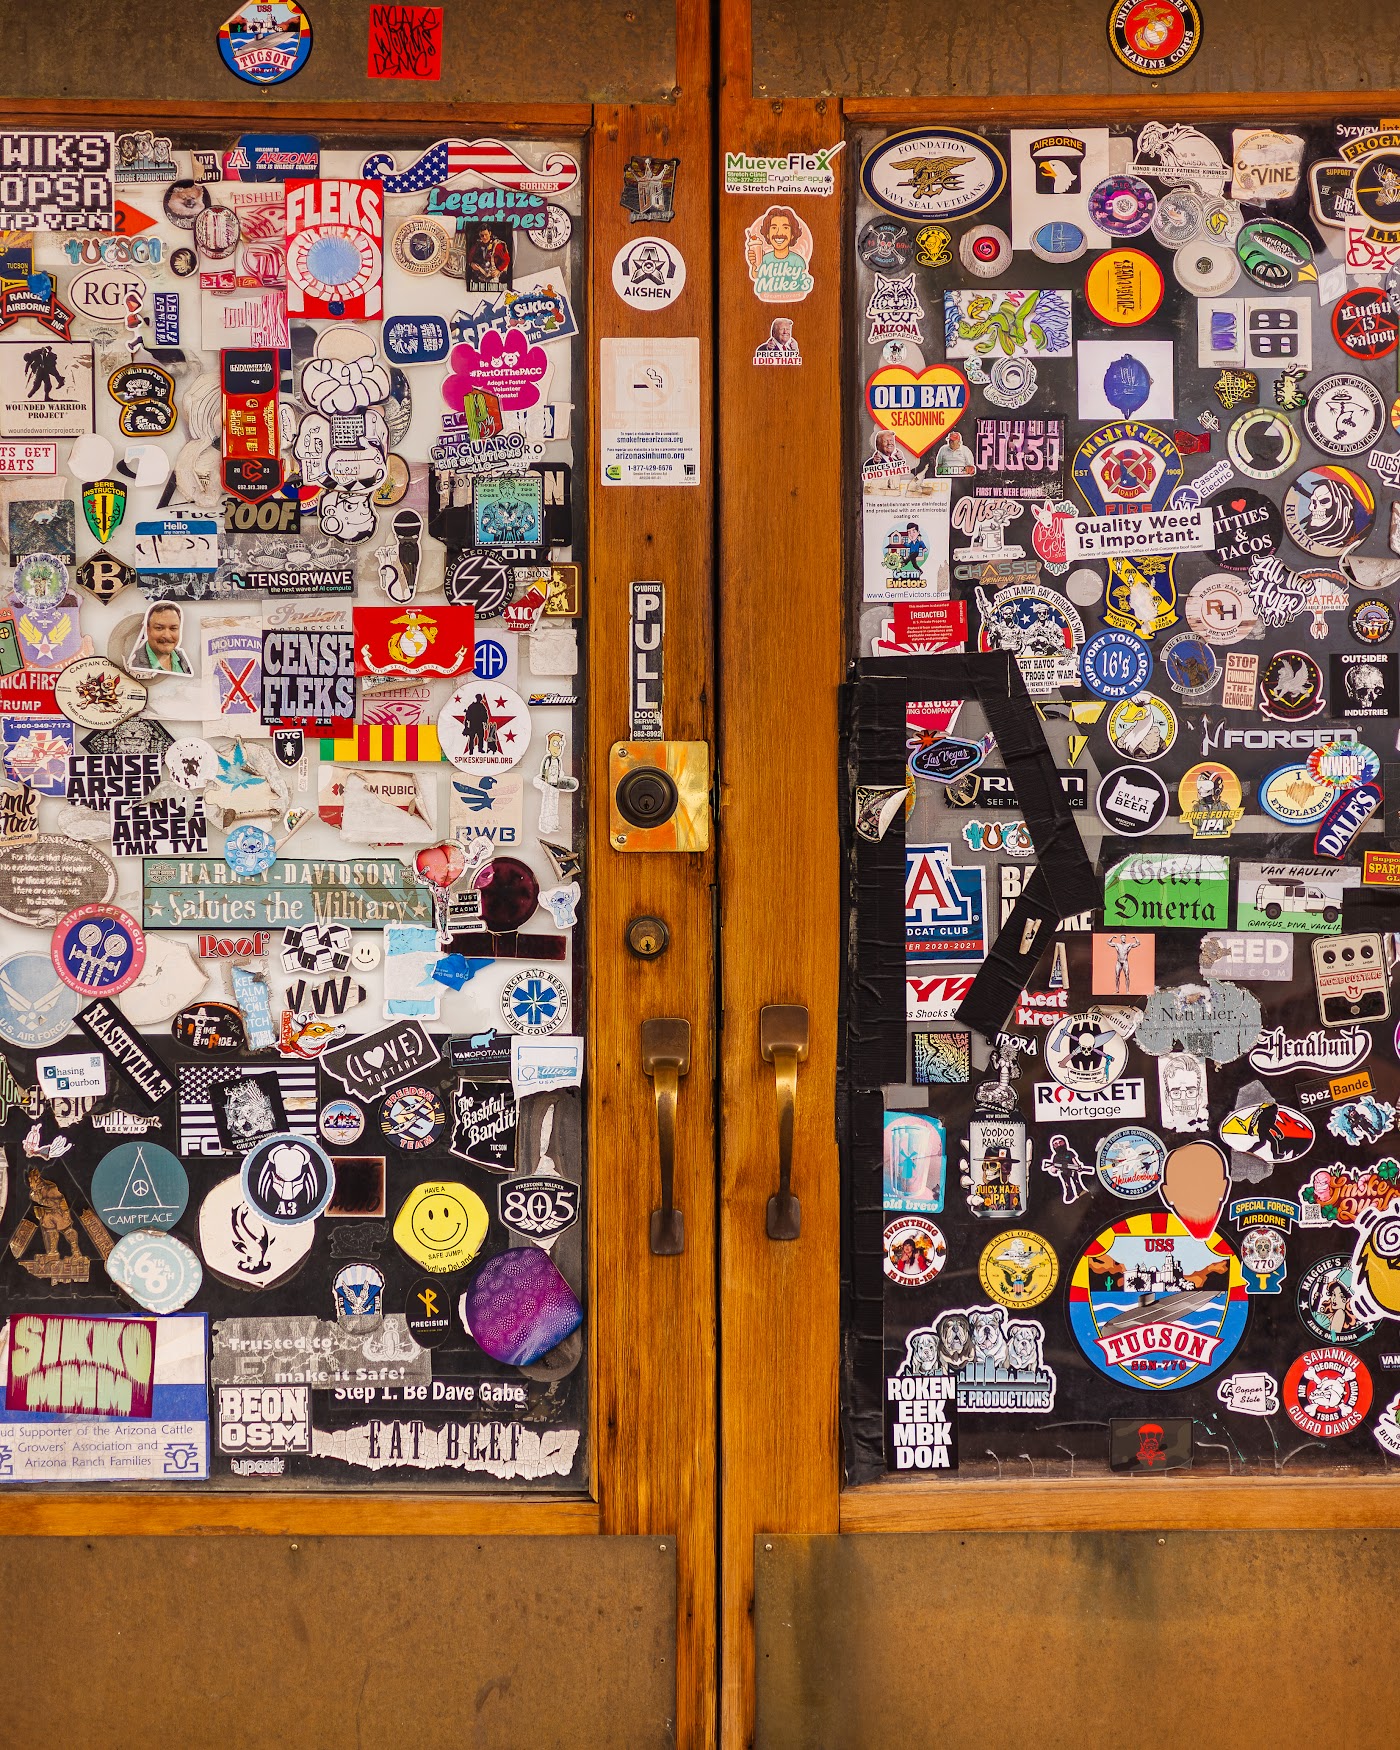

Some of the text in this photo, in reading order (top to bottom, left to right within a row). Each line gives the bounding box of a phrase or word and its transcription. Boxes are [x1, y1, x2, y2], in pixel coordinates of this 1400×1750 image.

[257, 5, 273, 13] USS
[1122, 30, 1194, 69] MARINE CORPS
[239, 49, 291, 69] TUCSON
[898, 140, 967, 154] FOUNDATION
[1033, 137, 1083, 151] AIRBORNE
[257, 152, 318, 165] ARIZONA
[1253, 166, 1297, 186] VINE
[519, 182, 559, 191] SORINEX
[726, 184, 742, 192] We
[742, 184, 775, 192] Stretch
[803, 185, 832, 194] Away!
[427, 188, 547, 212] Legalize
[881, 182, 986, 210] NAVY SEAL VETERANS
[287, 181, 382, 237] FLEKS
[758, 276, 812, 292] Mike's
[624, 287, 672, 299] AKSHEN
[6, 301, 50, 314] AIRBORNE
[1341, 300, 1392, 321] Lucky
[872, 324, 918, 336] ARIZONA
[869, 333, 923, 343] ORTHOPAEDICS
[1345, 329, 1396, 347] Saloon
[479, 360, 489, 368] Be
[470, 367, 542, 378] #PartOfThePACC
[493, 385, 521, 393] Volunteer
[874, 386, 915, 408] OLD
[5, 403, 87, 411] WOUNDED WARRIOR
[28, 411, 65, 419] PROJECT
[891, 411, 945, 426] SEASONING
[8, 427, 85, 435] woundedwarriorproject.org
[616, 436, 684, 444] smokefreearizona.org
[24, 446, 51, 458] GET
[615, 452, 685, 460] arizonasinhumo.org
[83, 486, 126, 497] INSTRUCTOR
[163, 522, 189, 531] Hello
[1075, 512, 1201, 535] Quality Weed
[1079, 529, 1200, 549] Is Important.
[1217, 534, 1273, 562] TACOS
[962, 552, 1018, 560] PAINTING
[248, 572, 352, 587] TENSORWAVE
[886, 577, 928, 589] Evictors
[640, 585, 661, 593] VORTEX
[867, 591, 948, 600] www.GermEvictors.com
[910, 610, 948, 619] [REDACTED]
[263, 633, 354, 677] CENSE
[634, 593, 661, 710] PULL
[1034, 659, 1055, 669] HAVOC
[1228, 655, 1257, 669] STOP
[1341, 654, 1388, 663] OUTSIDER
[1102, 685, 1128, 696] PHX
[921, 707, 955, 715] COMPANY
[1344, 708, 1389, 717] INDUSTRIES
[9, 722, 71, 730] 1-800-949-7173
[276, 732, 300, 740] UYC
[68, 754, 160, 777] CENSE
[454, 755, 513, 765] SPIKESK9FUND.ORG
[1271, 791, 1333, 818] EXOPLANETS
[1182, 808, 1242, 820] JUICE FORCE
[1200, 819, 1224, 831] IPA
[1319, 789, 1377, 857] DALE'S
[112, 818, 207, 842] ARSEN
[113, 839, 208, 856] TMK TYL
[1260, 865, 1339, 878] VAN HAULIN'
[458, 893, 478, 902] JUST
[169, 888, 407, 926] Salutes the Military
[450, 905, 479, 913] PEACHY
[940, 926, 969, 935] CLUB
[925, 942, 977, 950] 2020-2021
[502, 970, 568, 1008] SEARCH AND RESCUE
[915, 1009, 948, 1018] Shocks
[17, 1018, 69, 1042] AIR FORCE
[82, 1002, 172, 1102] NASHVILLE
[44, 1065, 85, 1079] Chasing
[56, 1077, 100, 1090] Bourbon
[385, 1086, 435, 1108] FREEDOM
[1300, 1078, 1369, 1104] Spez Bande
[1059, 1106, 1121, 1118] Mortgage
[105, 1126, 146, 1134] BREWING
[981, 1127, 1015, 1137] VOODOO
[399, 1135, 434, 1150] TEAM
[982, 1136, 1015, 1148] RANGER
[975, 1184, 1020, 1195] JUICY HAZE
[504, 1191, 575, 1223] 805
[907, 1200, 939, 1212] brew
[1235, 1201, 1295, 1215] SPECIAL FORCES
[1243, 1215, 1286, 1227] AIRBORNE
[1144, 1238, 1175, 1252] USS
[428, 1249, 464, 1260] SAFE JUMP!
[410, 1319, 450, 1329] PRECISION
[1108, 1322, 1209, 1360] TUCSON
[1131, 1360, 1187, 1371] SSN-770
[1303, 1348, 1360, 1370] SAVANNAH
[275, 1367, 405, 1383] make it Safe!
[403, 1381, 525, 1402] Be Dave Gabe
[887, 1376, 956, 1401] ROKEN
[968, 1390, 1050, 1407] PRODUCTIONS
[898, 1400, 946, 1423] EEK
[19, 1424, 193, 1439] Supporter of the Arizona Cattle
[893, 1422, 953, 1446] MBK
[18, 1440, 158, 1452] Growers' Association and
[368, 1419, 523, 1462] EAT BEEF
[25, 1456, 152, 1468] Arizona Ranch Families
[896, 1446, 951, 1469] DOA
